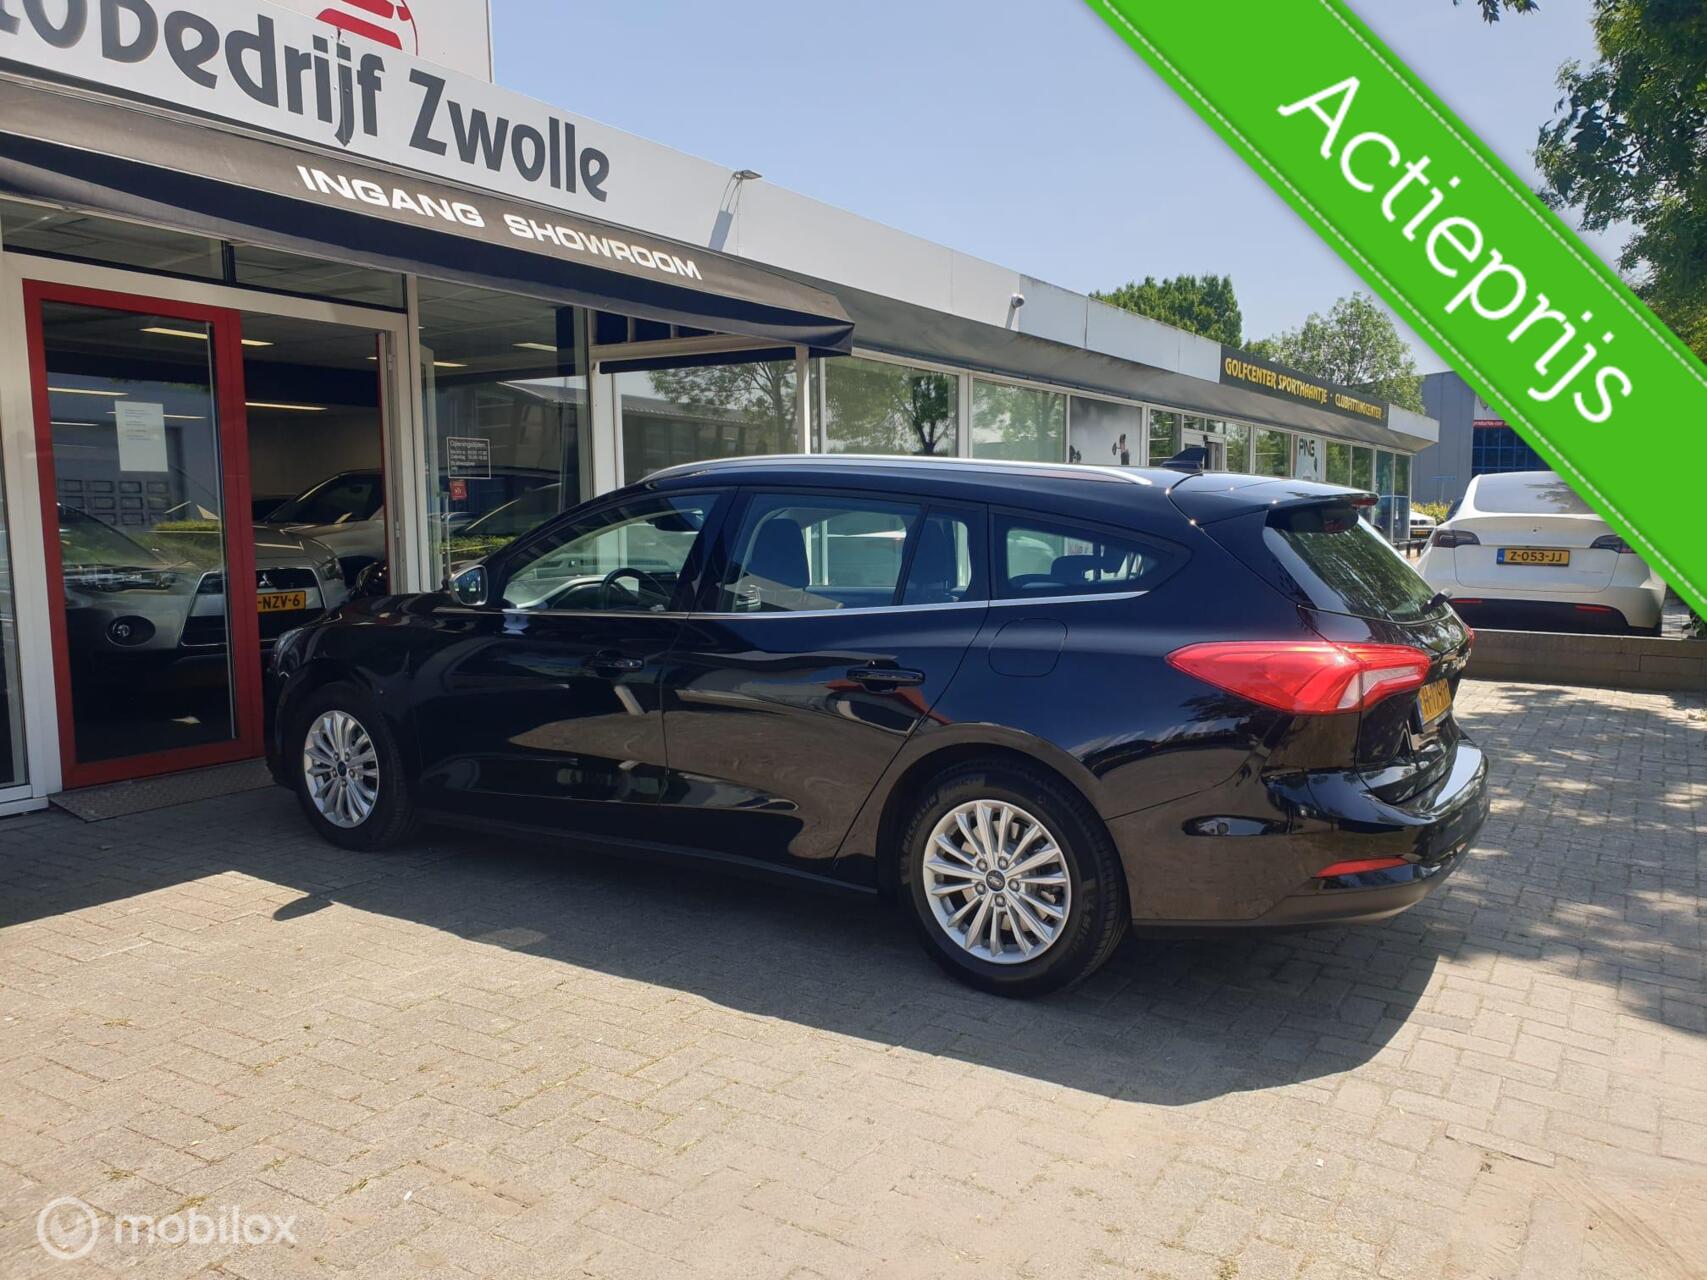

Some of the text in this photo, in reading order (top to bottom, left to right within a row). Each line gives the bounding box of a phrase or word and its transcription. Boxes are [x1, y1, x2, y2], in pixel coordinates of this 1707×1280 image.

[409, 68, 610, 201] Zwolle
[297, 165, 702, 280] INGANG SHOWROOM
[1225, 357, 1277, 389] GOLFCENTER
[1509, 550, 1562, 562] Z-053-JJ
